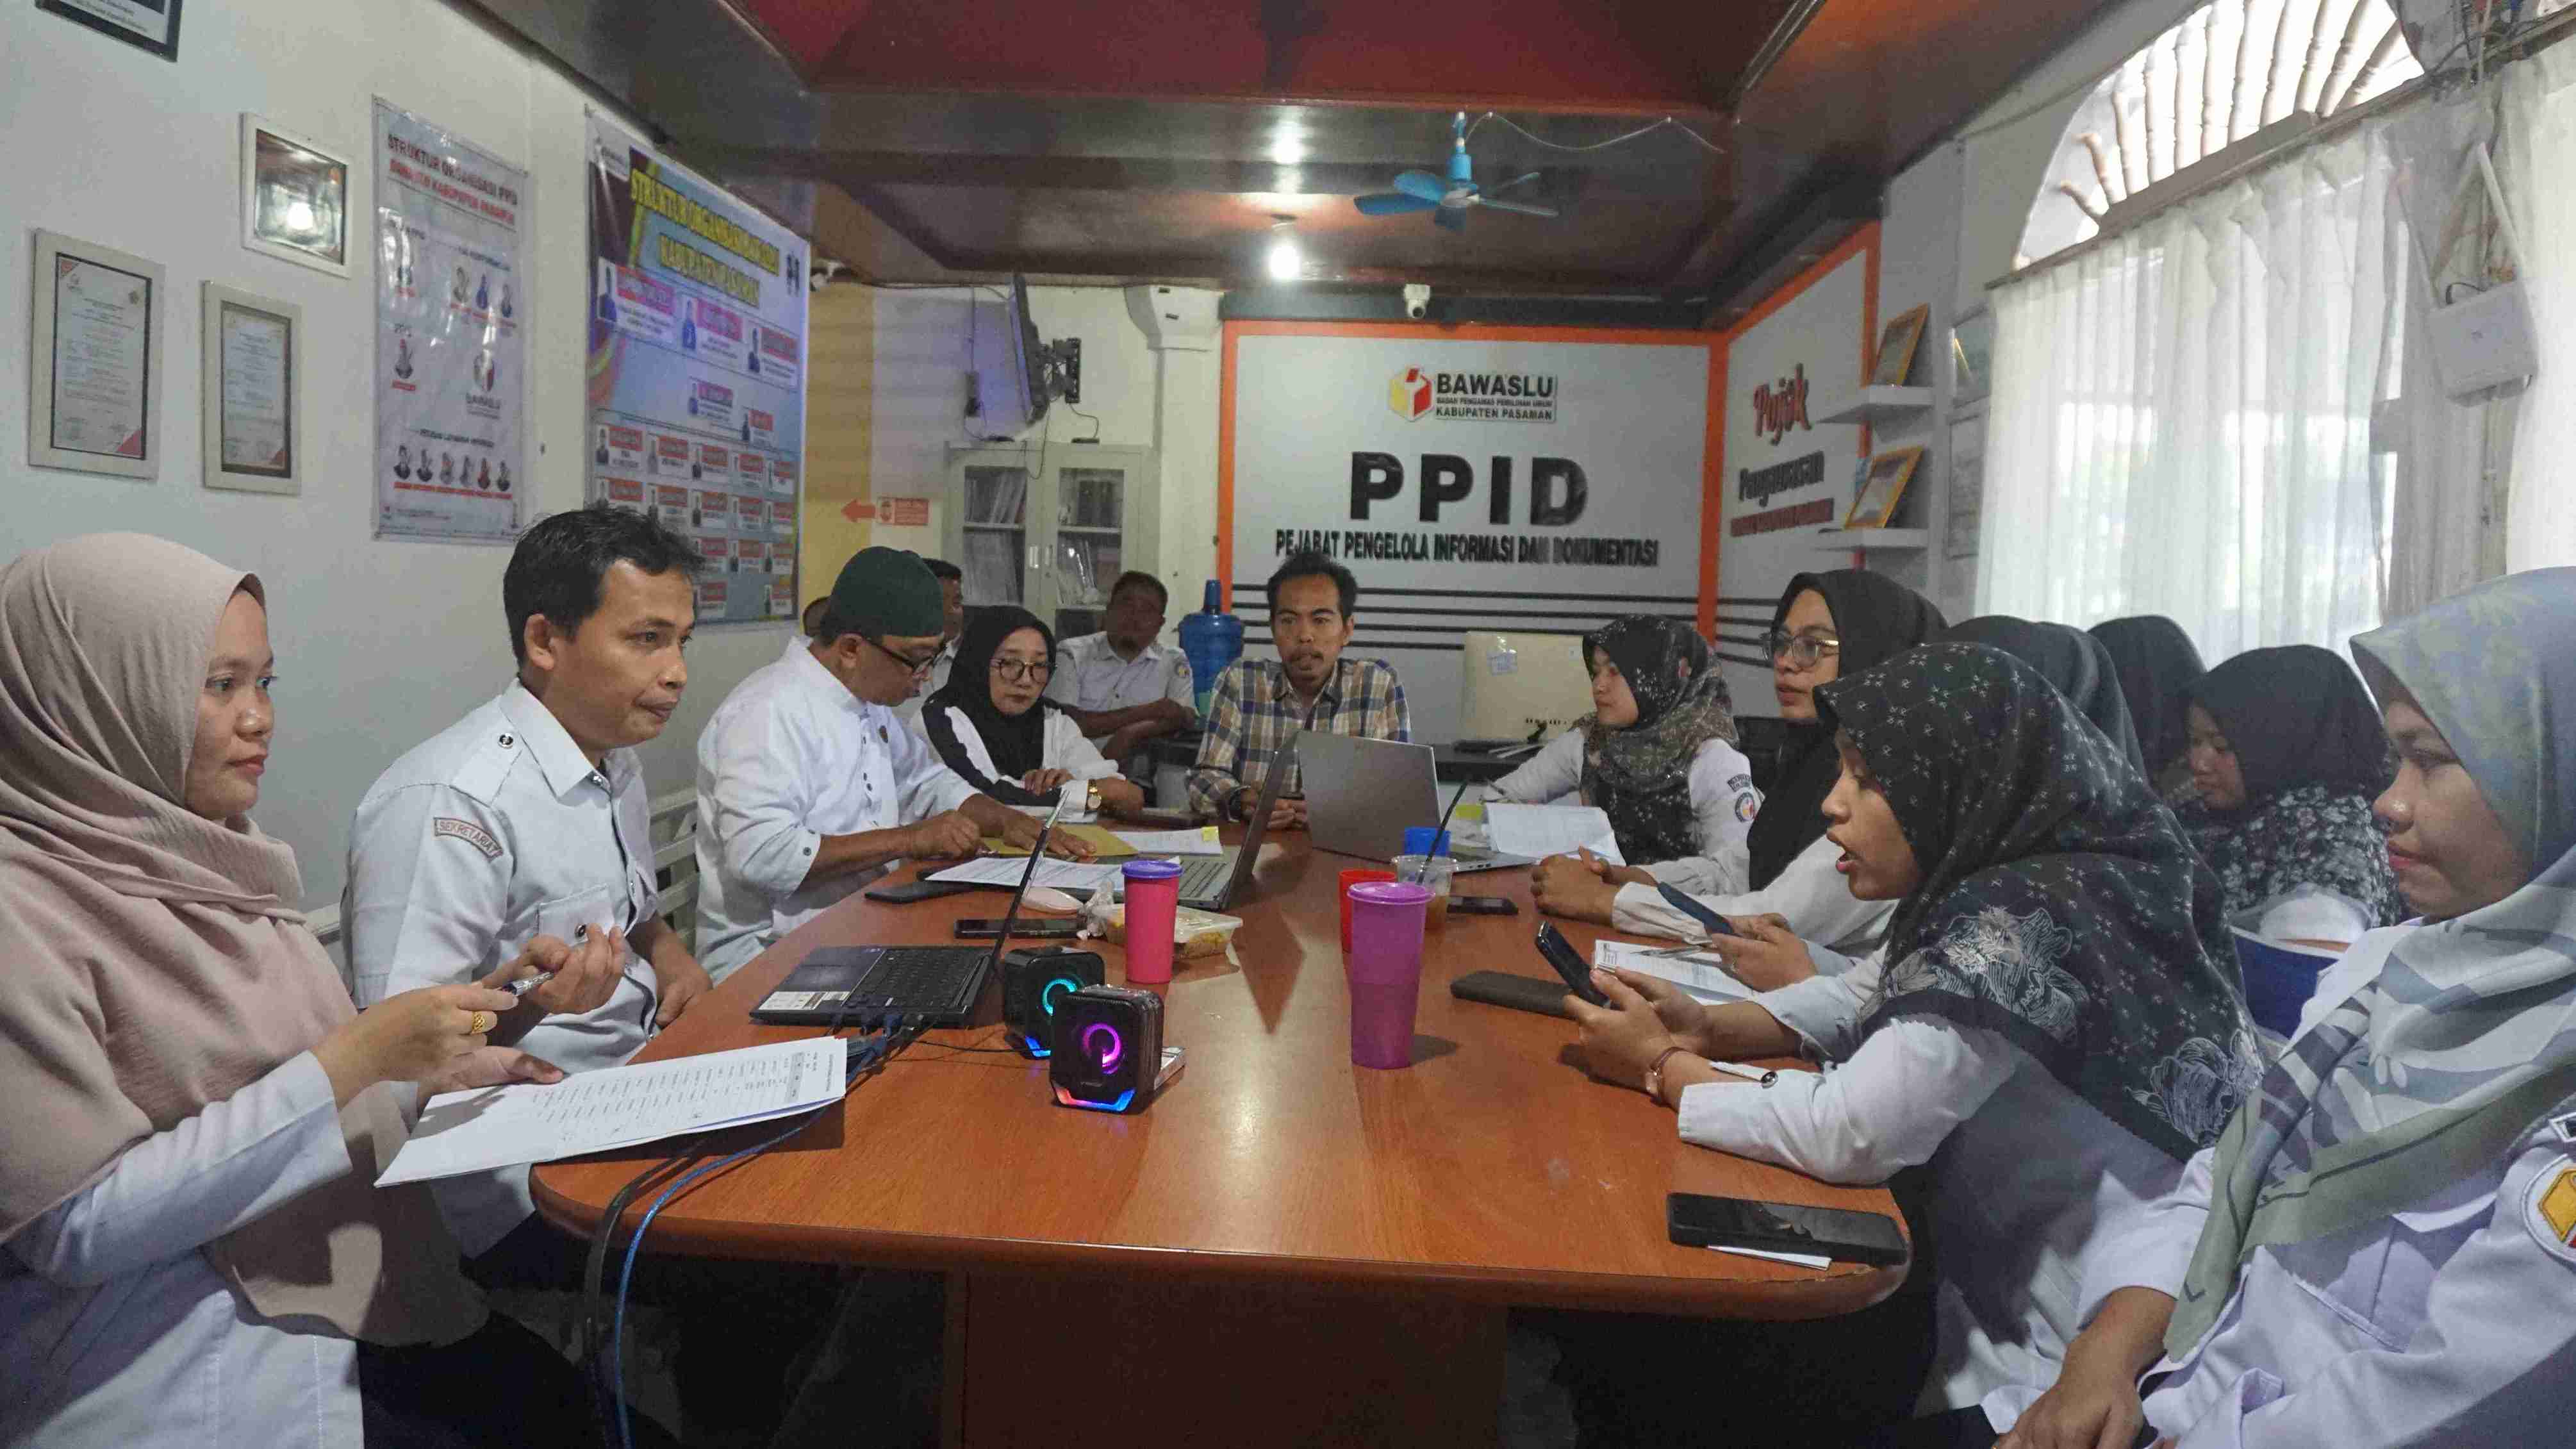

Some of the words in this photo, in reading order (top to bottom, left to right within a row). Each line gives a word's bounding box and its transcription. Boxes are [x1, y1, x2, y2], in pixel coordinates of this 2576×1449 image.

[1437, 373, 1553, 397] BAWASLU
[1436, 406, 1498, 418] KABUPATEN
[1502, 408, 1553, 420] PASAMAN
[1350, 451, 1589, 526] PPID
[1276, 529, 1340, 558] PEJABAT
[1344, 531, 1429, 561] PENGELOLA
[1433, 533, 1515, 563] INFORMASI
[1517, 535, 1550, 564] DAN
[1552, 537, 1659, 567] DOKUMENTASI
[439, 821, 499, 854] SEKRETARIAT
